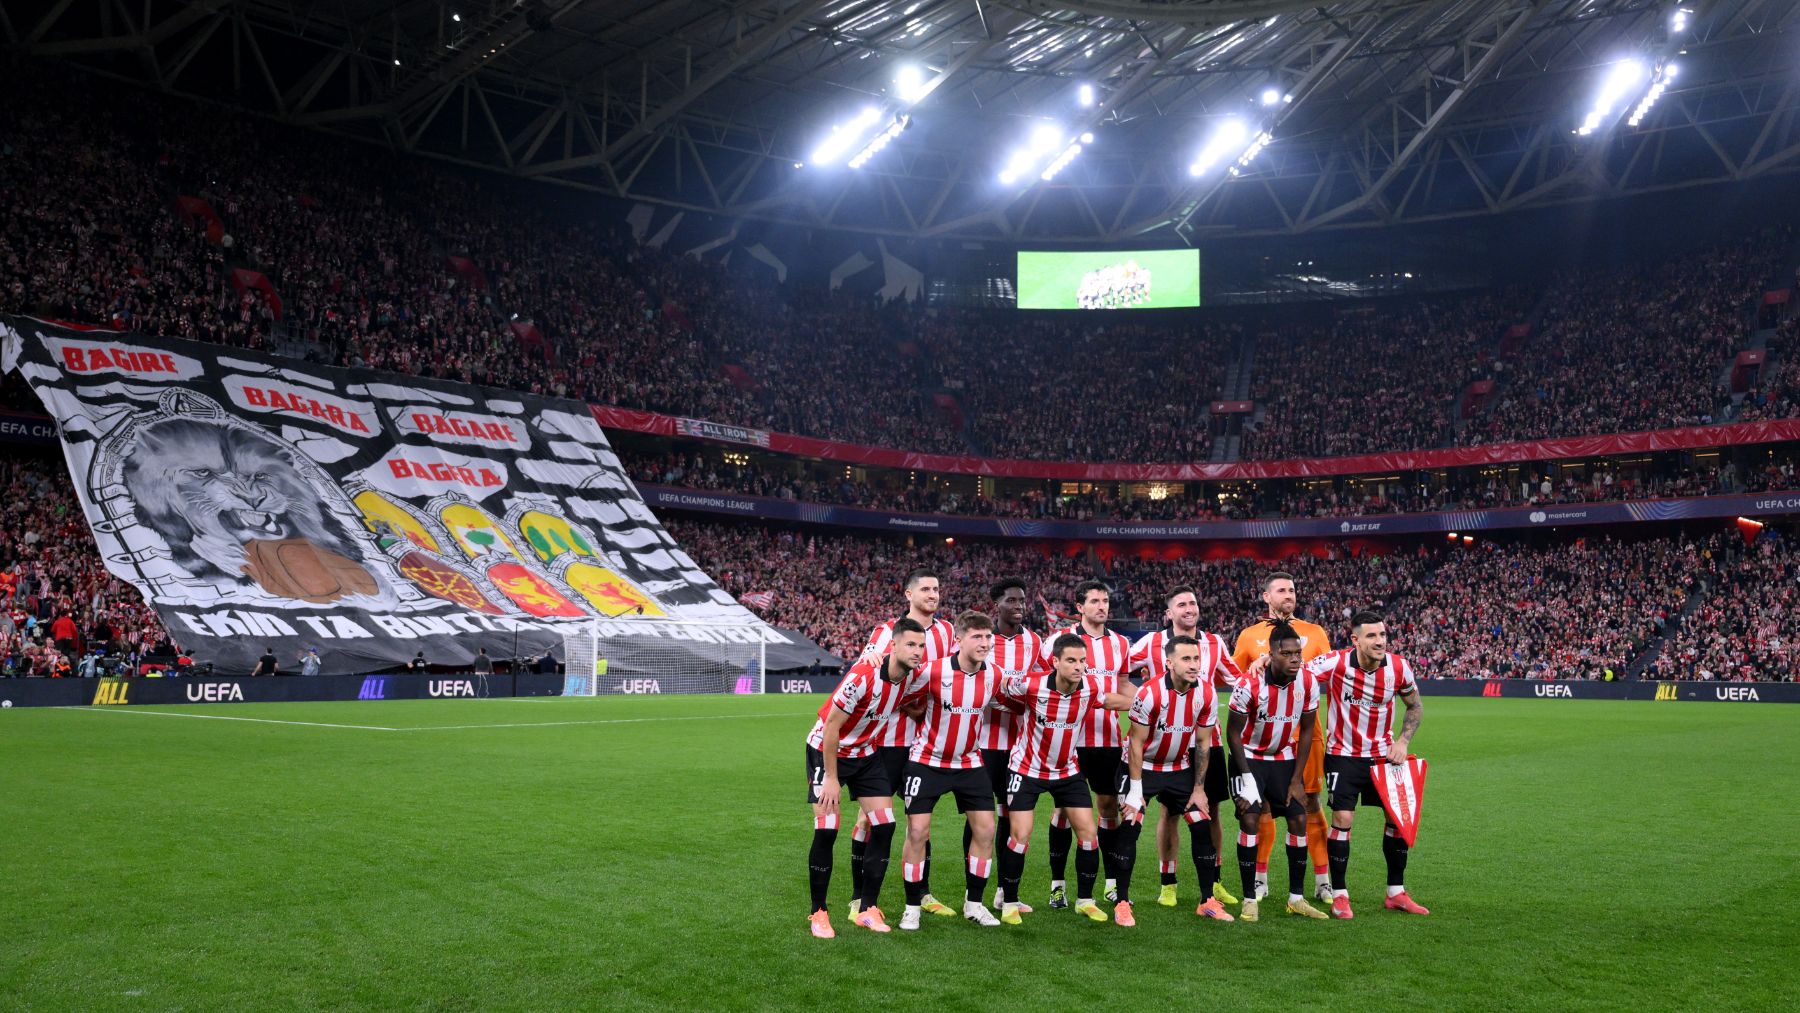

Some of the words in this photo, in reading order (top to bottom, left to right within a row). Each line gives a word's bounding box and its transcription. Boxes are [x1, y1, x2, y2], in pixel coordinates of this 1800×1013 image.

[62, 346, 179, 375] BAGIRE
[242, 385, 370, 434] BAGARA
[0, 422, 28, 436] EFA
[411, 412, 519, 443] BAGARE
[703, 424, 722, 435] ALL
[723, 427, 748, 439] IRON
[659, 492, 680, 504] UEFA
[681, 495, 726, 508] CHAMPIONS
[727, 500, 756, 511] LEAGUE
[1755, 499, 1784, 509] UEFA
[1548, 511, 1587, 519] mastercard
[1096, 527, 1118, 535] UEFA
[1119, 527, 1167, 535] CHAMPIONS
[1168, 527, 1200, 535] LEAGUE
[1351, 522, 1367, 531] JUST
[1367, 521, 1381, 530] EAT
[174, 609, 299, 638] EKIN
[296, 614, 375, 639] TA
[94, 680, 129, 706] ALL
[186, 682, 244, 701] UEFA
[358, 679, 385, 699] ALL
[429, 680, 475, 697] UEFA
[623, 679, 661, 694] UEFA
[781, 679, 812, 693] UEFA
[1483, 682, 1502, 697] ALL
[1534, 684, 1573, 698] UEFA
[1655, 684, 1678, 701] ALL
[1715, 687, 1760, 701] UEFA
[812, 766, 826, 785] 1
[1006, 773, 1023, 793] 16
[904, 776, 922, 796] 18
[1230, 775, 1244, 796] 10
